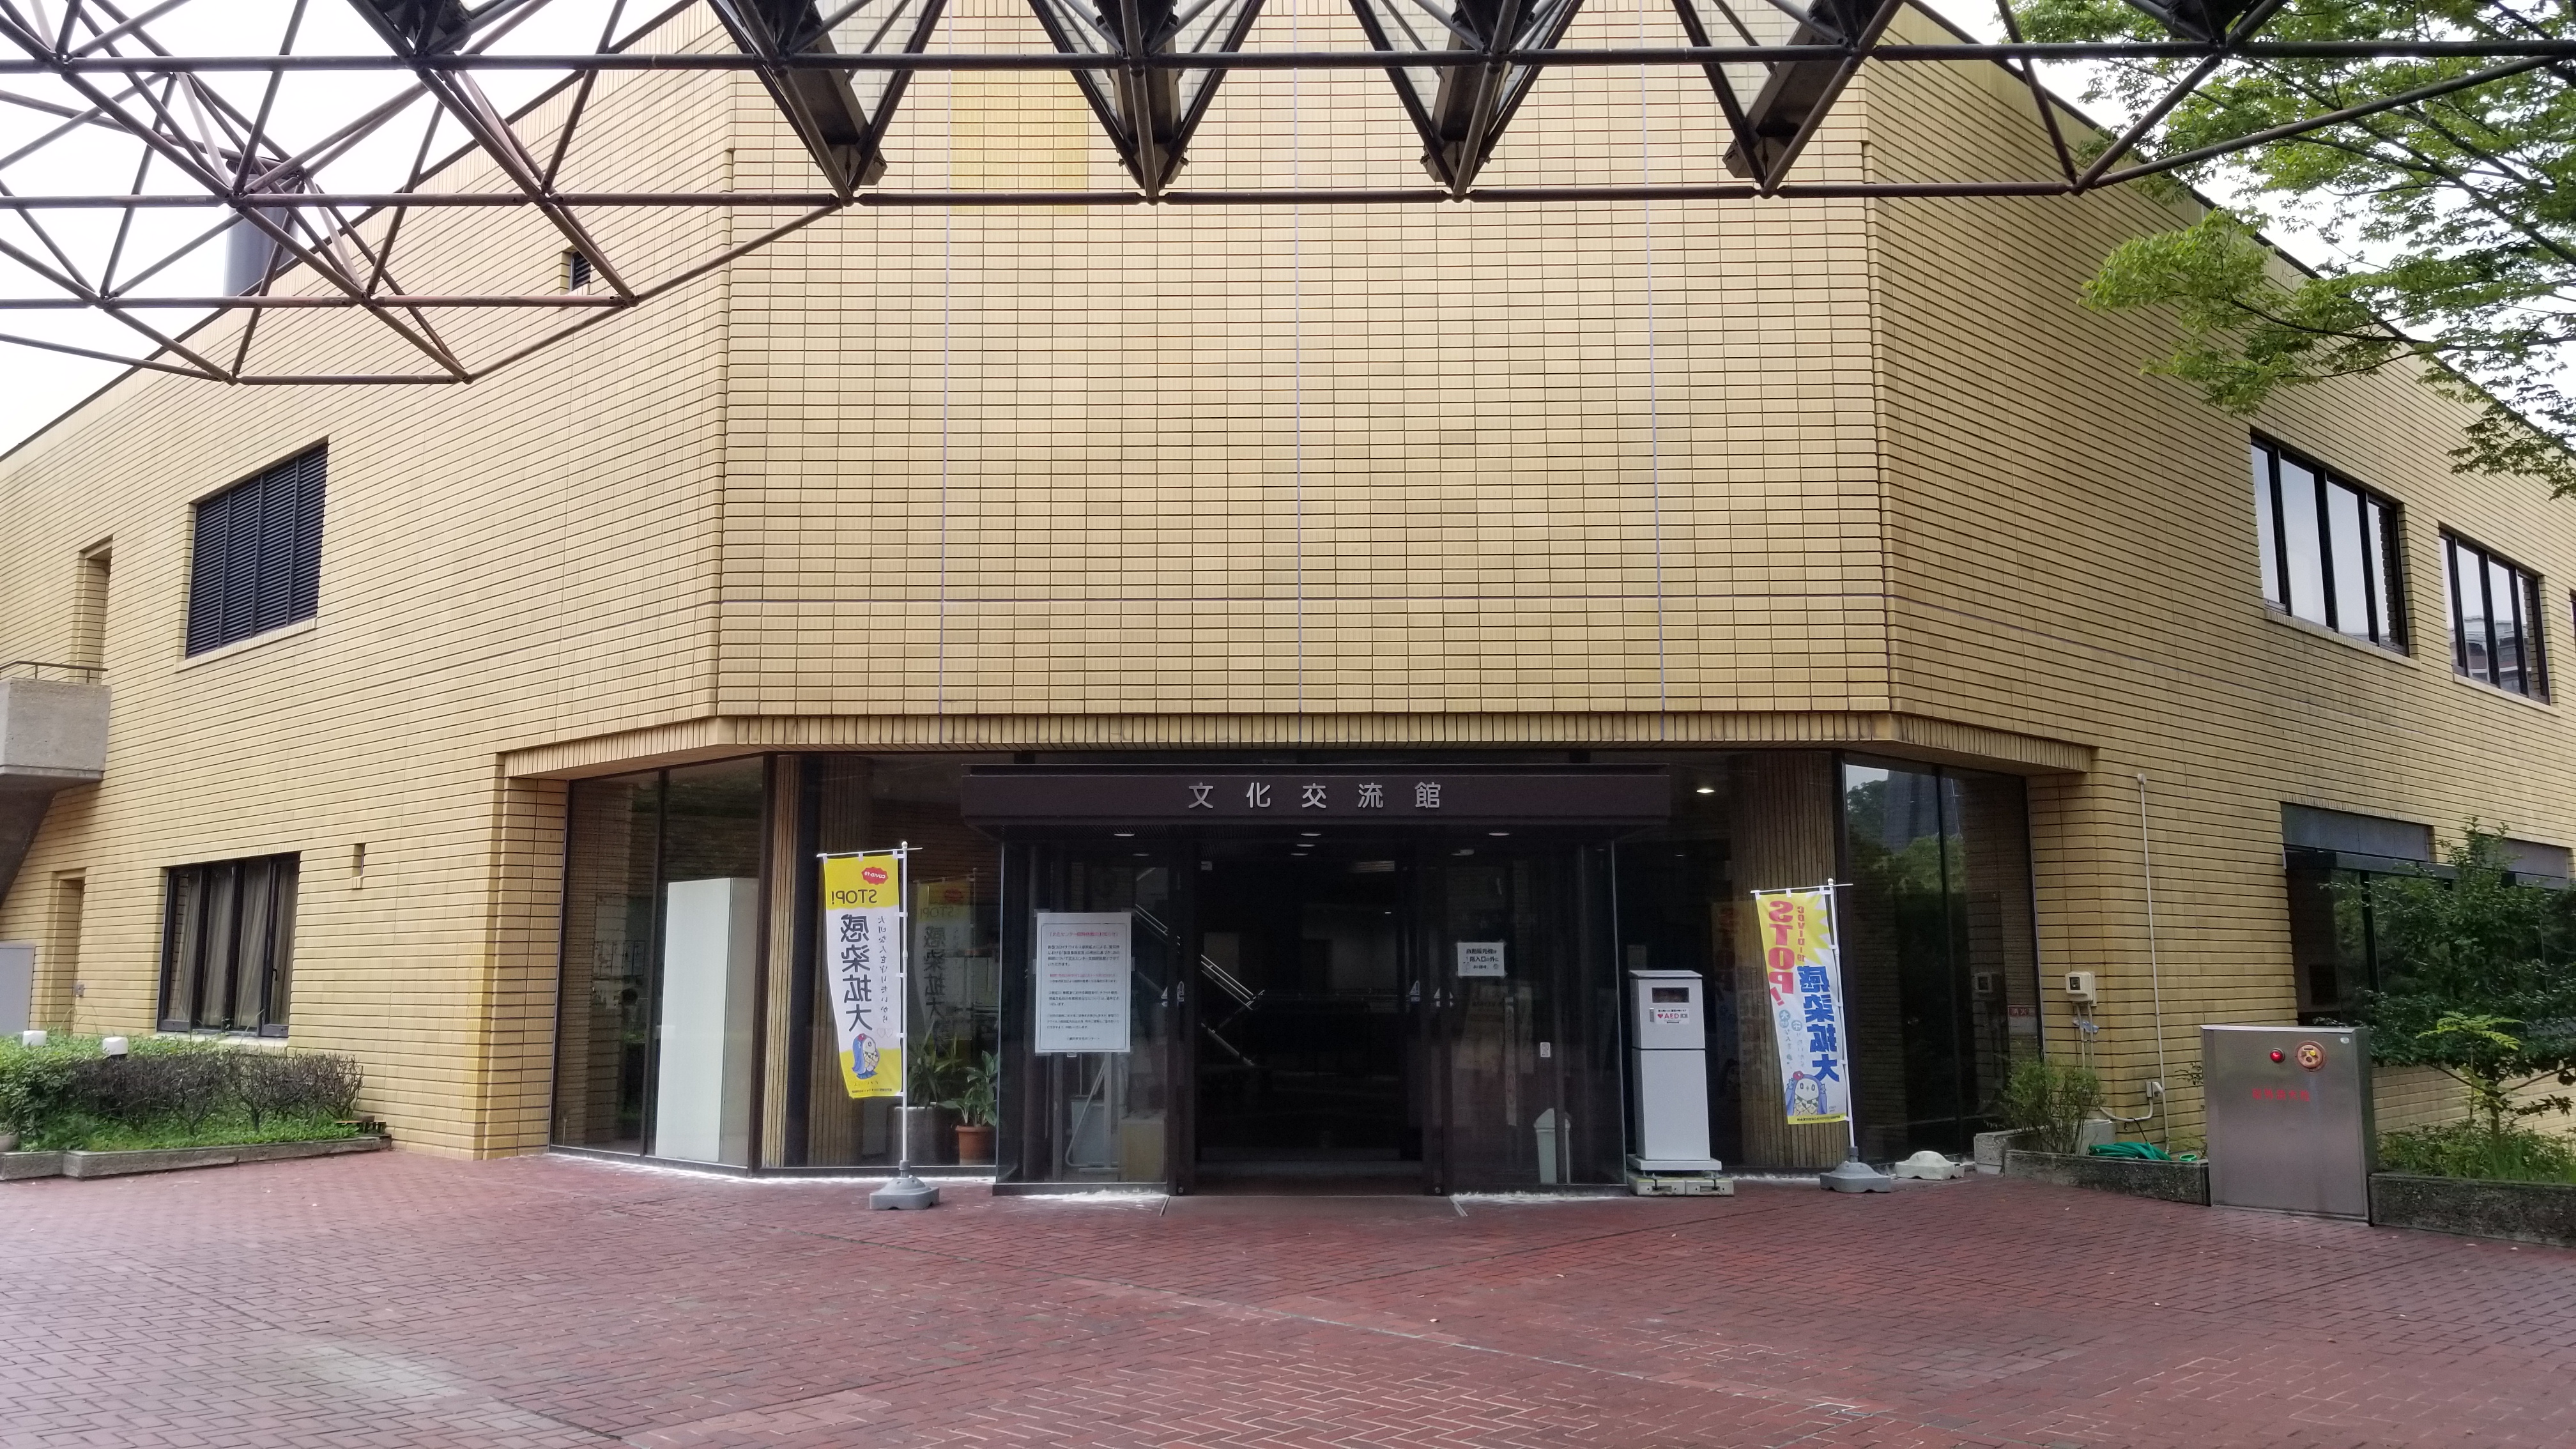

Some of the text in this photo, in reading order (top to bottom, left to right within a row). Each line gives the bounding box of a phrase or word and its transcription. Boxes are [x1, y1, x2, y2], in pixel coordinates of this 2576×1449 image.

[1188, 781, 1441, 809] 文化交流館
